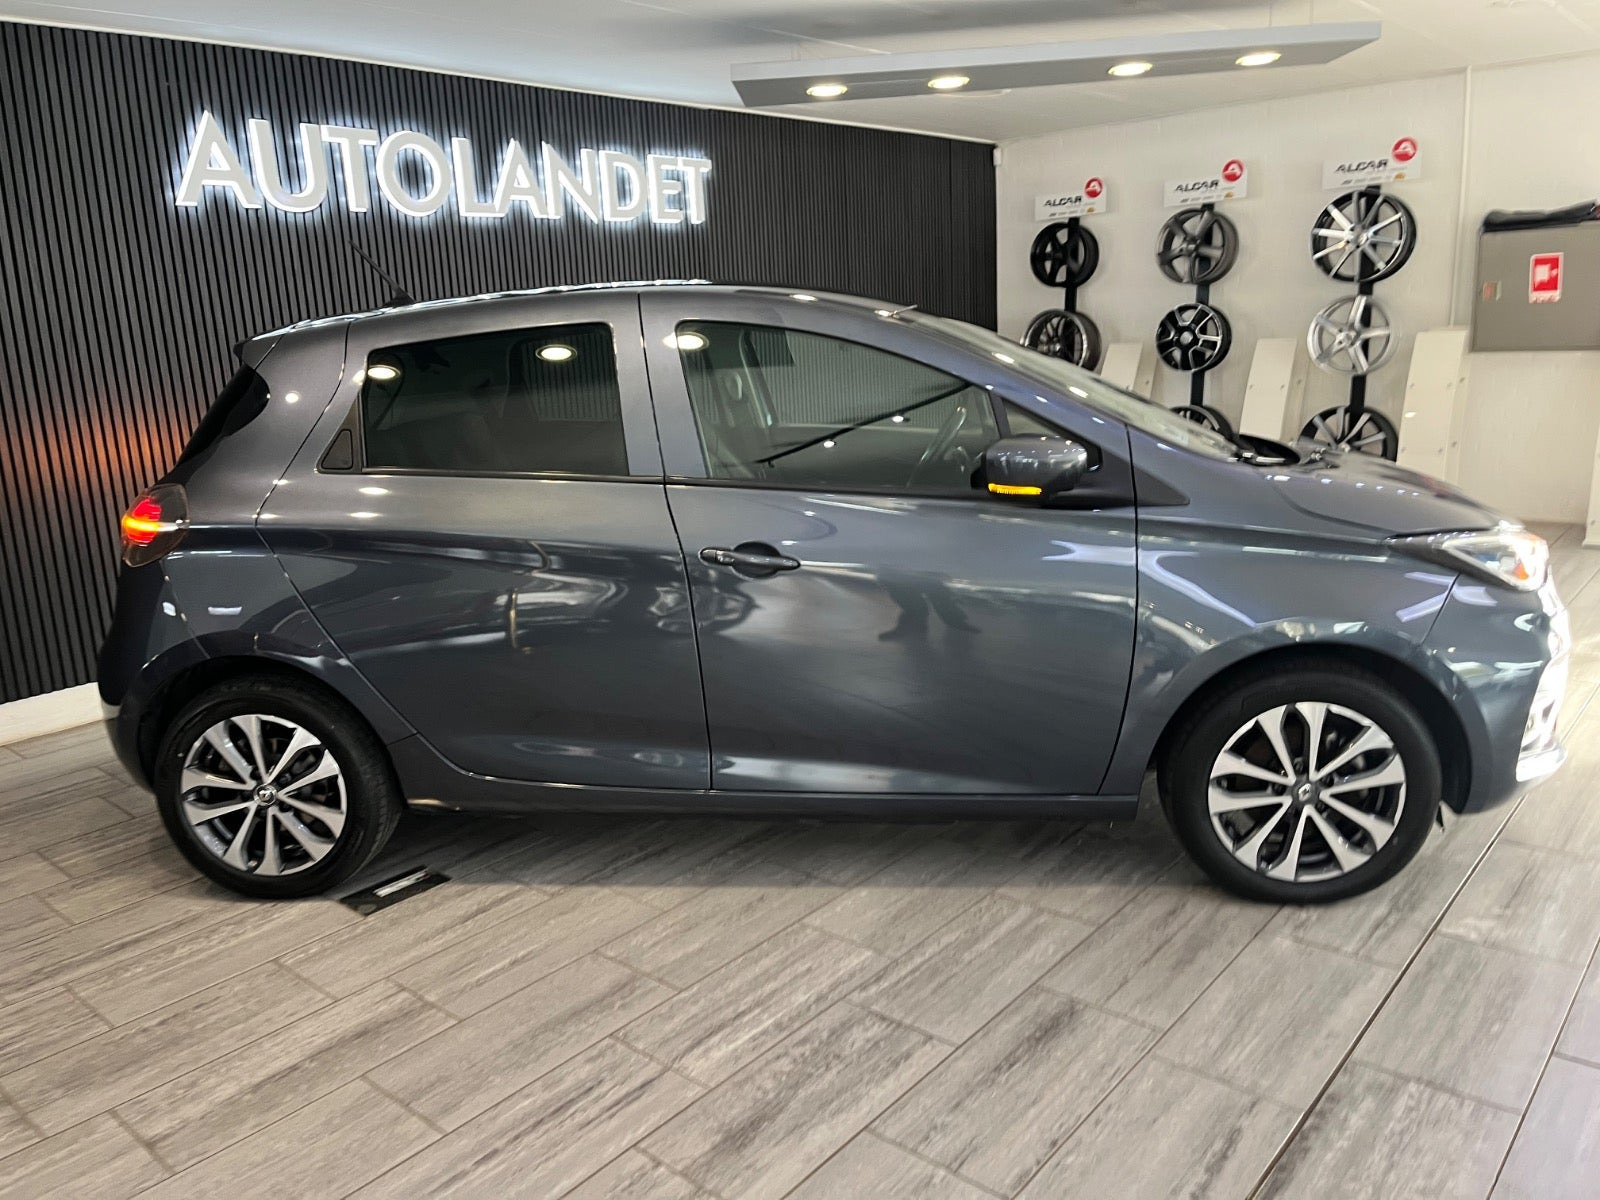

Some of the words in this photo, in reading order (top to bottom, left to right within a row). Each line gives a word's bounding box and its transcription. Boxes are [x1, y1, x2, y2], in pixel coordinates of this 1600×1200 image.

[174, 109, 712, 225] AUTOLANDET
[1334, 159, 1388, 173] ALCAR
[1175, 180, 1219, 192] ALCAR
[1043, 195, 1082, 207] ALCAR
